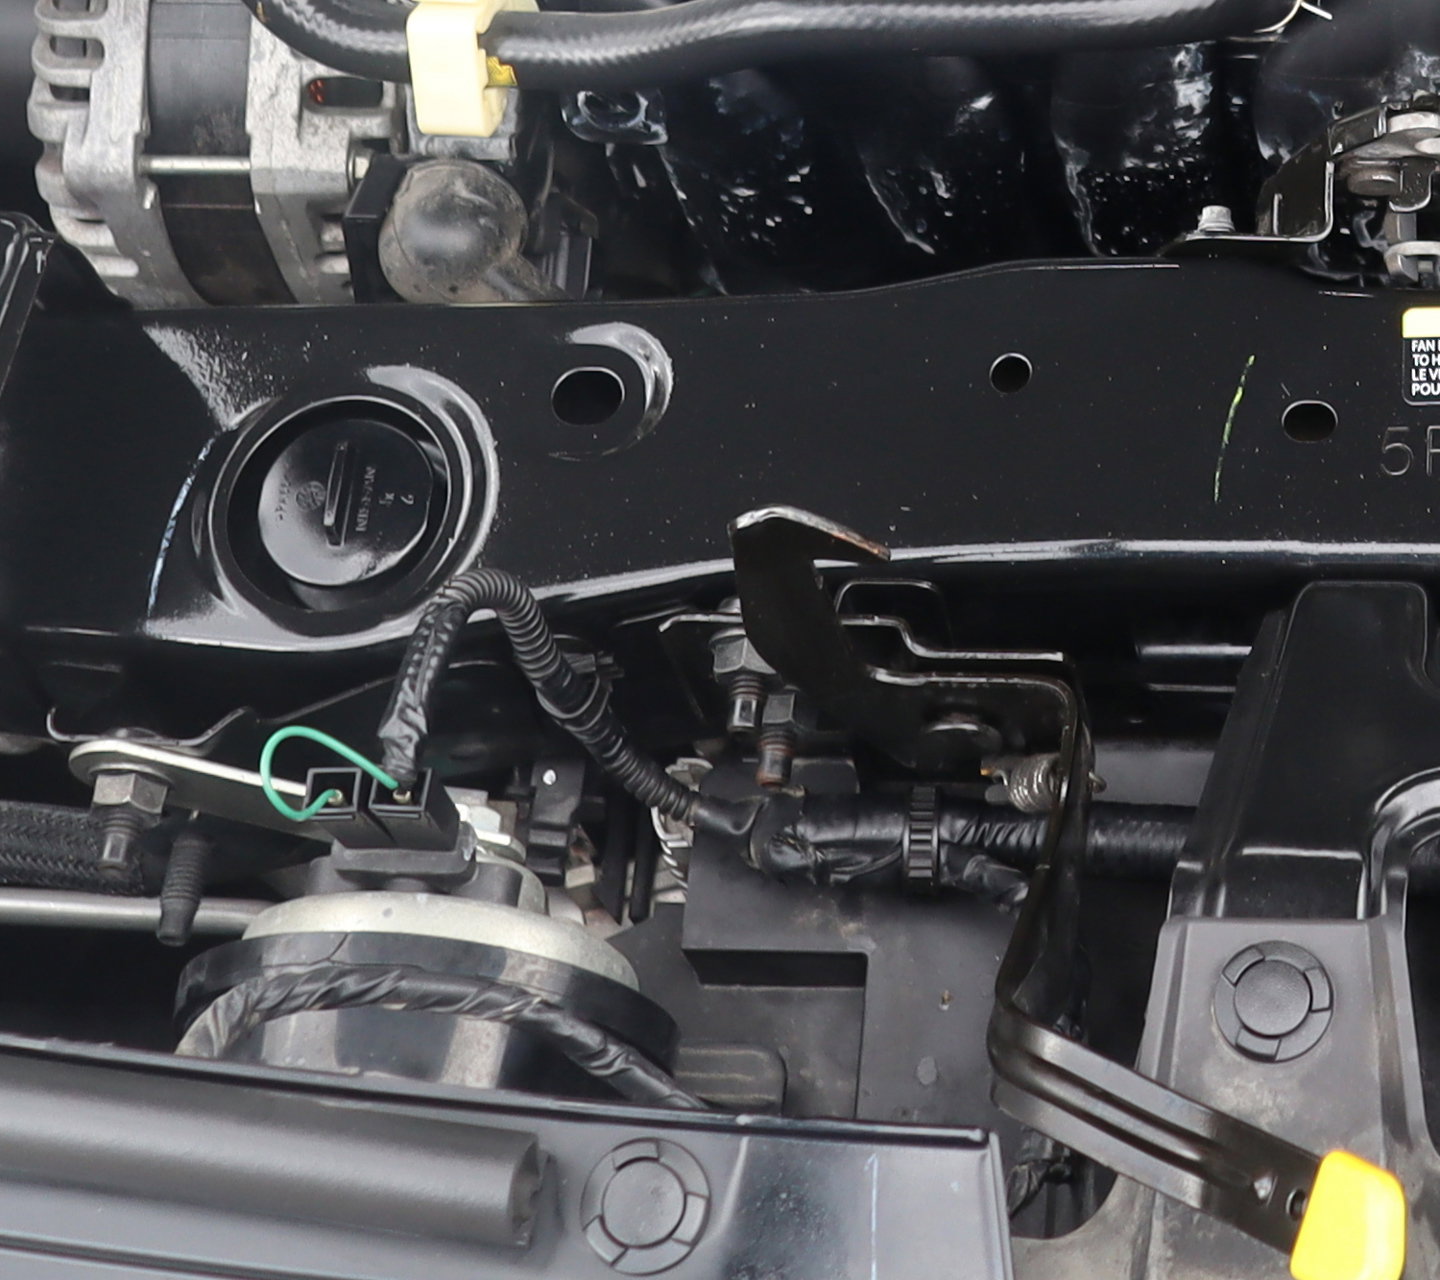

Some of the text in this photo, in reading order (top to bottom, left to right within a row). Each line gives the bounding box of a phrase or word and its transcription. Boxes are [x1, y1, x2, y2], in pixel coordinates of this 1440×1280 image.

[1411, 340, 1435, 353] FAN
[1413, 354, 1430, 367] TO
[1412, 369, 1427, 381] LE
